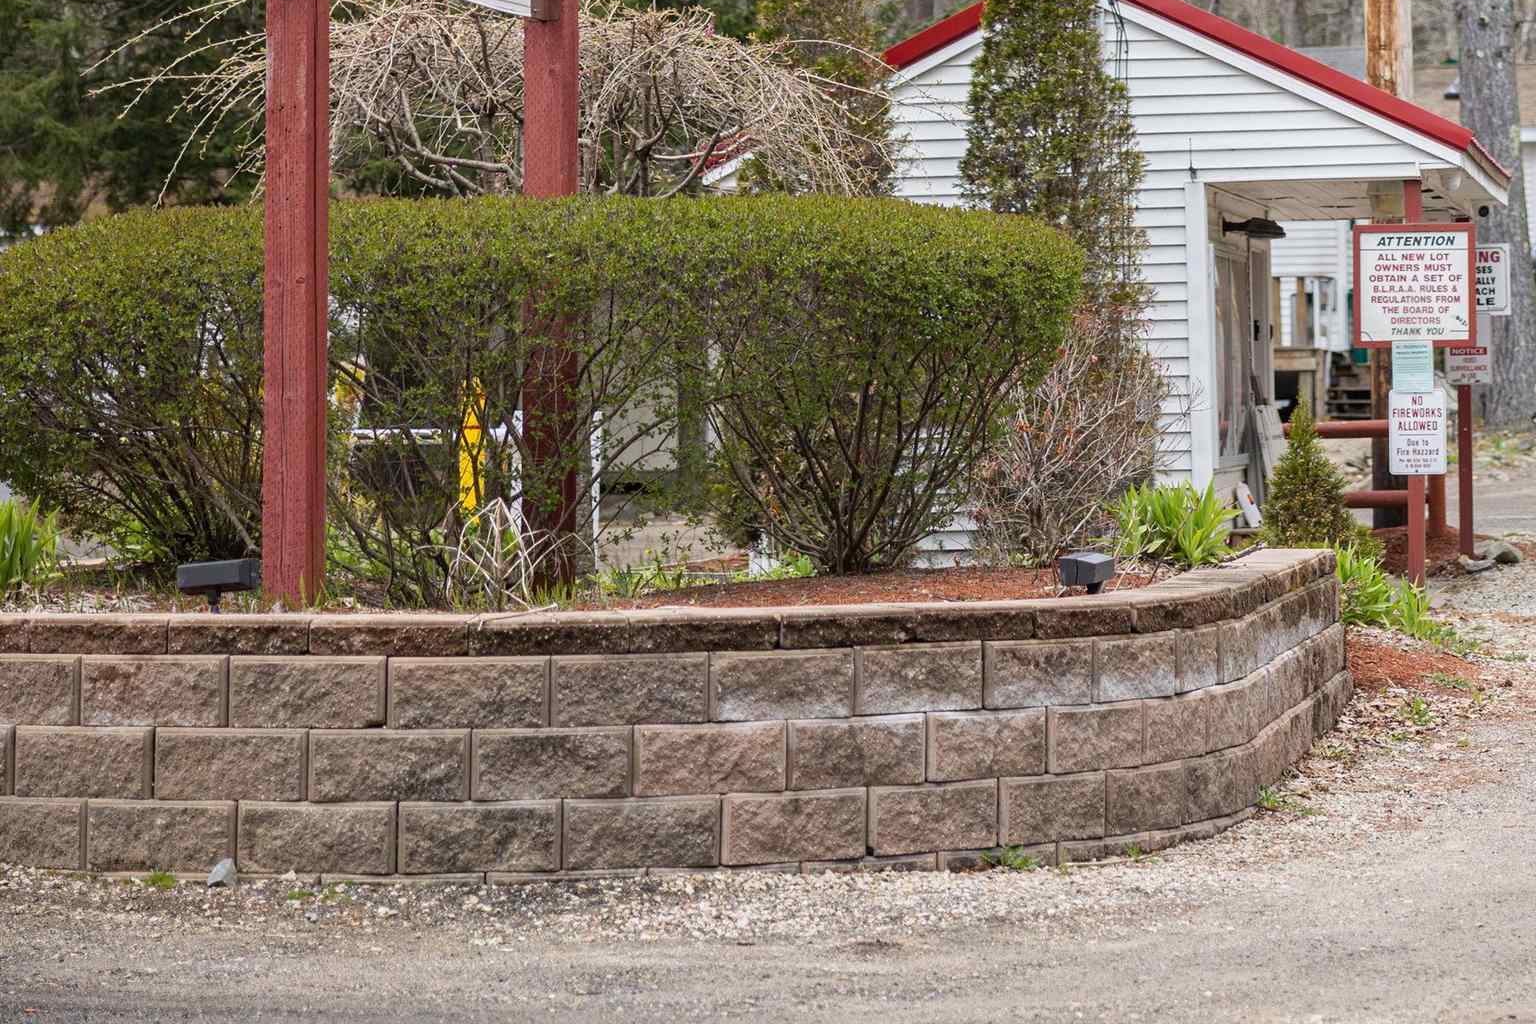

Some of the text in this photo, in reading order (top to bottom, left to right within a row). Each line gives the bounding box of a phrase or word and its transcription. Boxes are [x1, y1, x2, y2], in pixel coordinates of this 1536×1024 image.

[1377, 236, 1455, 246] ATTENTION
[1377, 253, 1449, 261] ALL NEW LOT
[1374, 264, 1452, 272] OWNERS MUST
[1369, 275, 1462, 283] OBTAIN A SET OF
[1420, 285, 1449, 293] RULES
[1452, 285, 1458, 293] &
[1371, 295, 1460, 304] REGULATIONS FROM
[1382, 306, 1450, 314] THE BOARD OF
[1391, 317, 1440, 325] DIRECTORS
[1391, 327, 1444, 336] THANK YOU
[1411, 396, 1423, 406] NO
[1392, 408, 1442, 418] FIREWORKS
[1398, 421, 1438, 431] ALLOWED
[1407, 438, 1420, 446] Due
[1396, 447, 1410, 455] Fire
